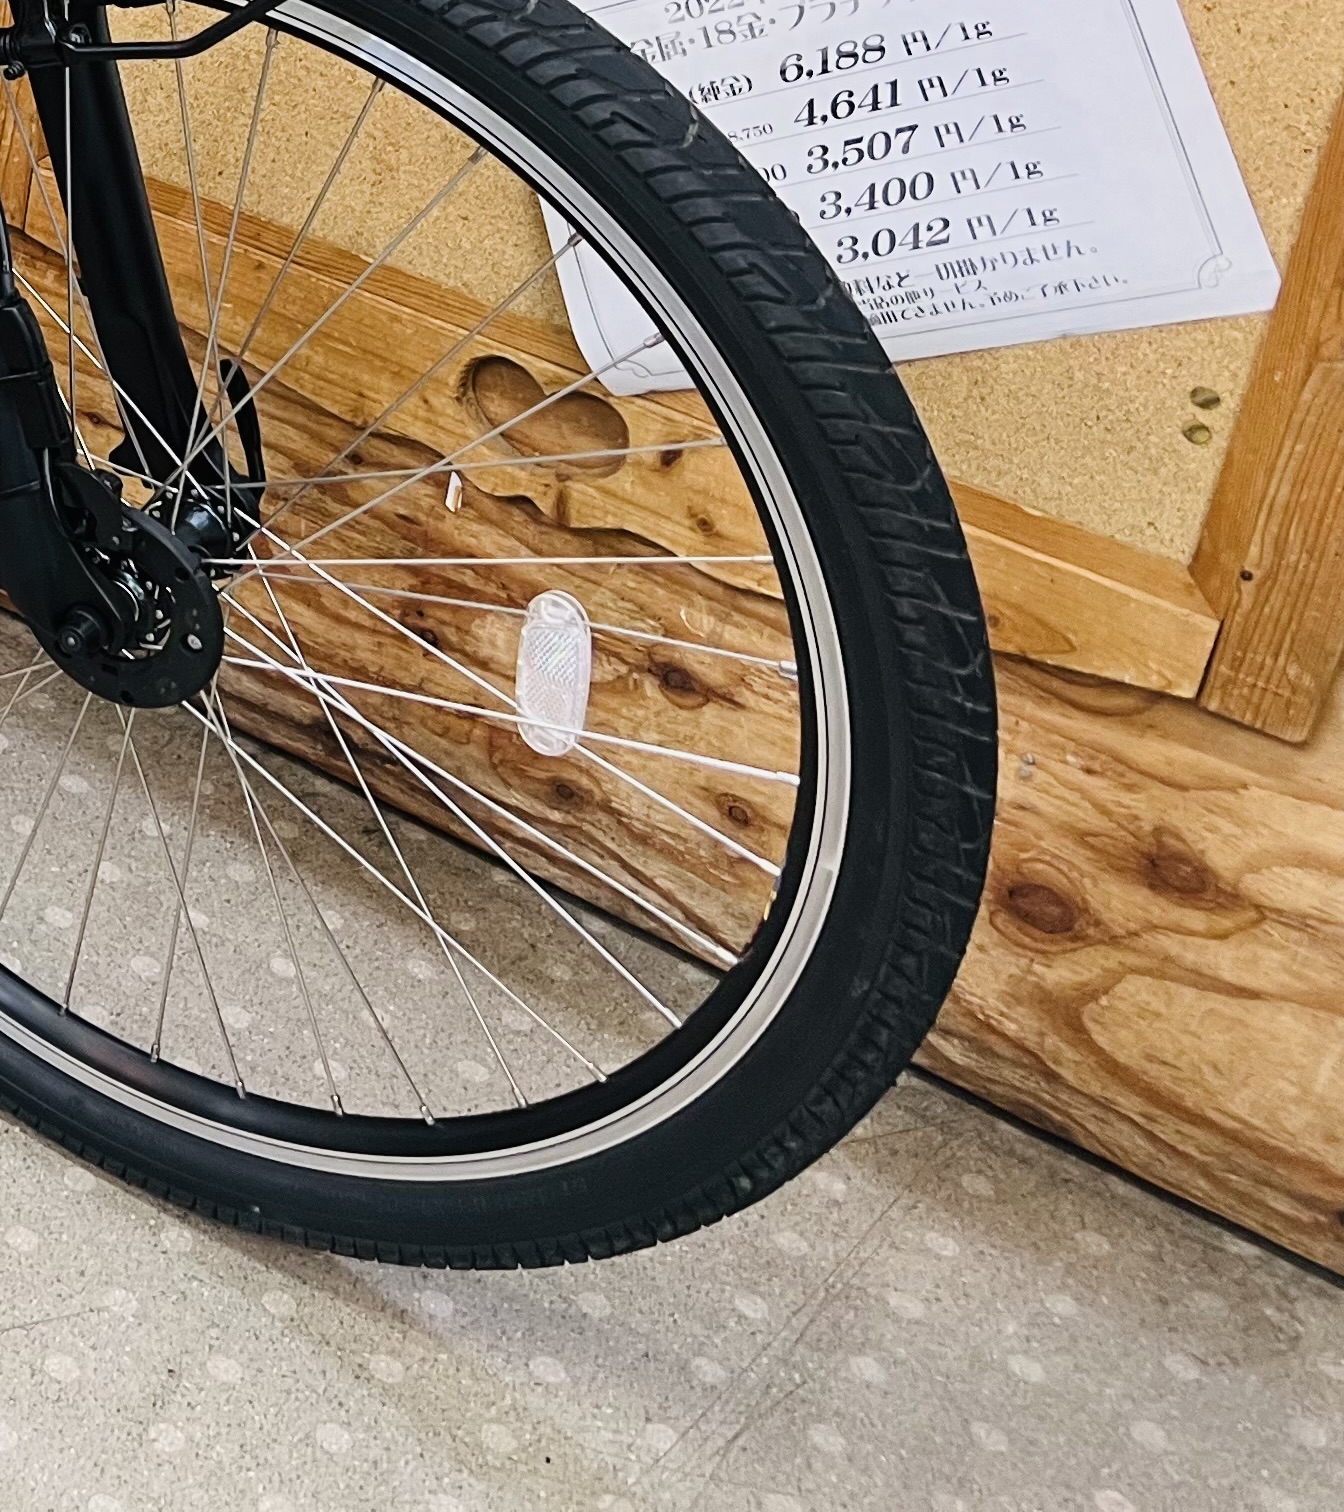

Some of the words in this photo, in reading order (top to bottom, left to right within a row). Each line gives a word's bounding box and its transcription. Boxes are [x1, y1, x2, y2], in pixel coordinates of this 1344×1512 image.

[778, 34, 888, 86] 6,188
[793, 78, 902, 128] 4,641
[805, 123, 919, 175] 3,507
[818, 170, 935, 221] 3,400
[835, 216, 952, 265] 3,042
